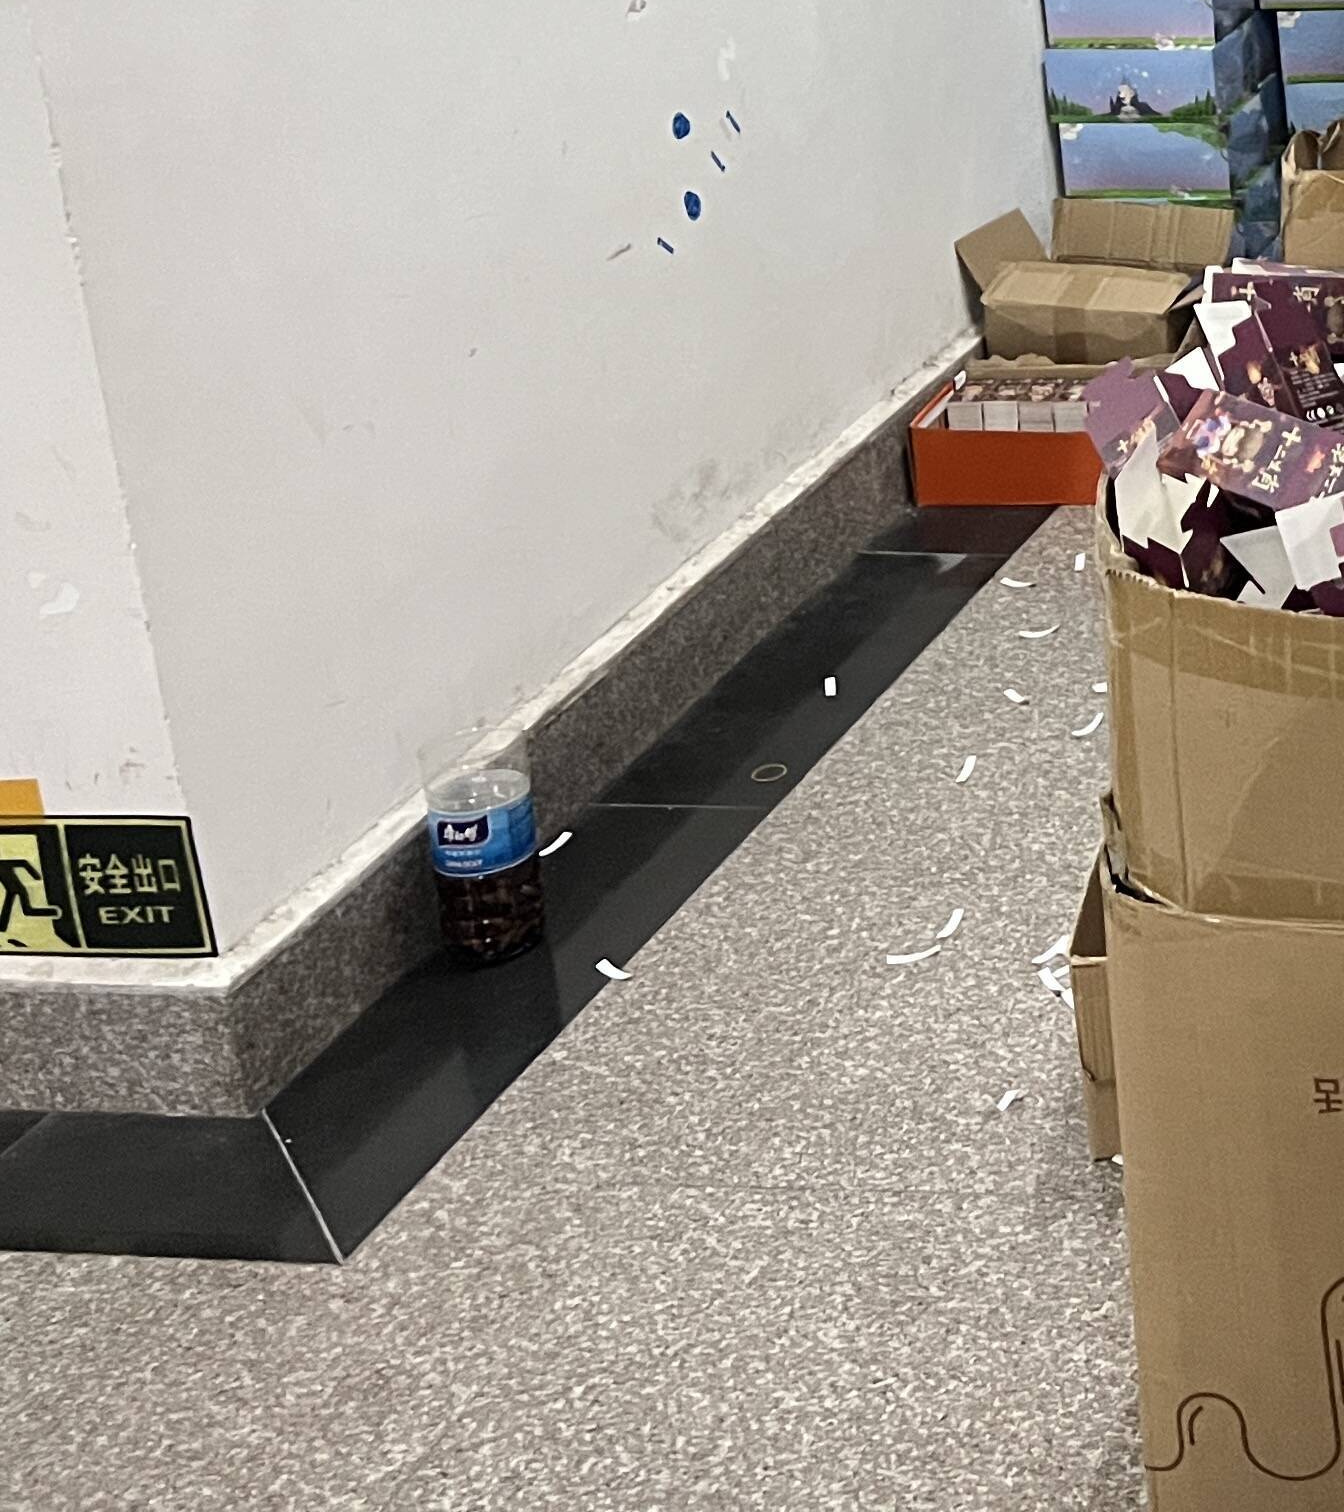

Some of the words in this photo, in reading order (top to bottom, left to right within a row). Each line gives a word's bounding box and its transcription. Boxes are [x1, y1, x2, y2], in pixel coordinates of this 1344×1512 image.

[1252, 426, 1303, 495] 十二生肖
[78, 852, 181, 895] 安全出口
[98, 906, 175, 925] EXIT
